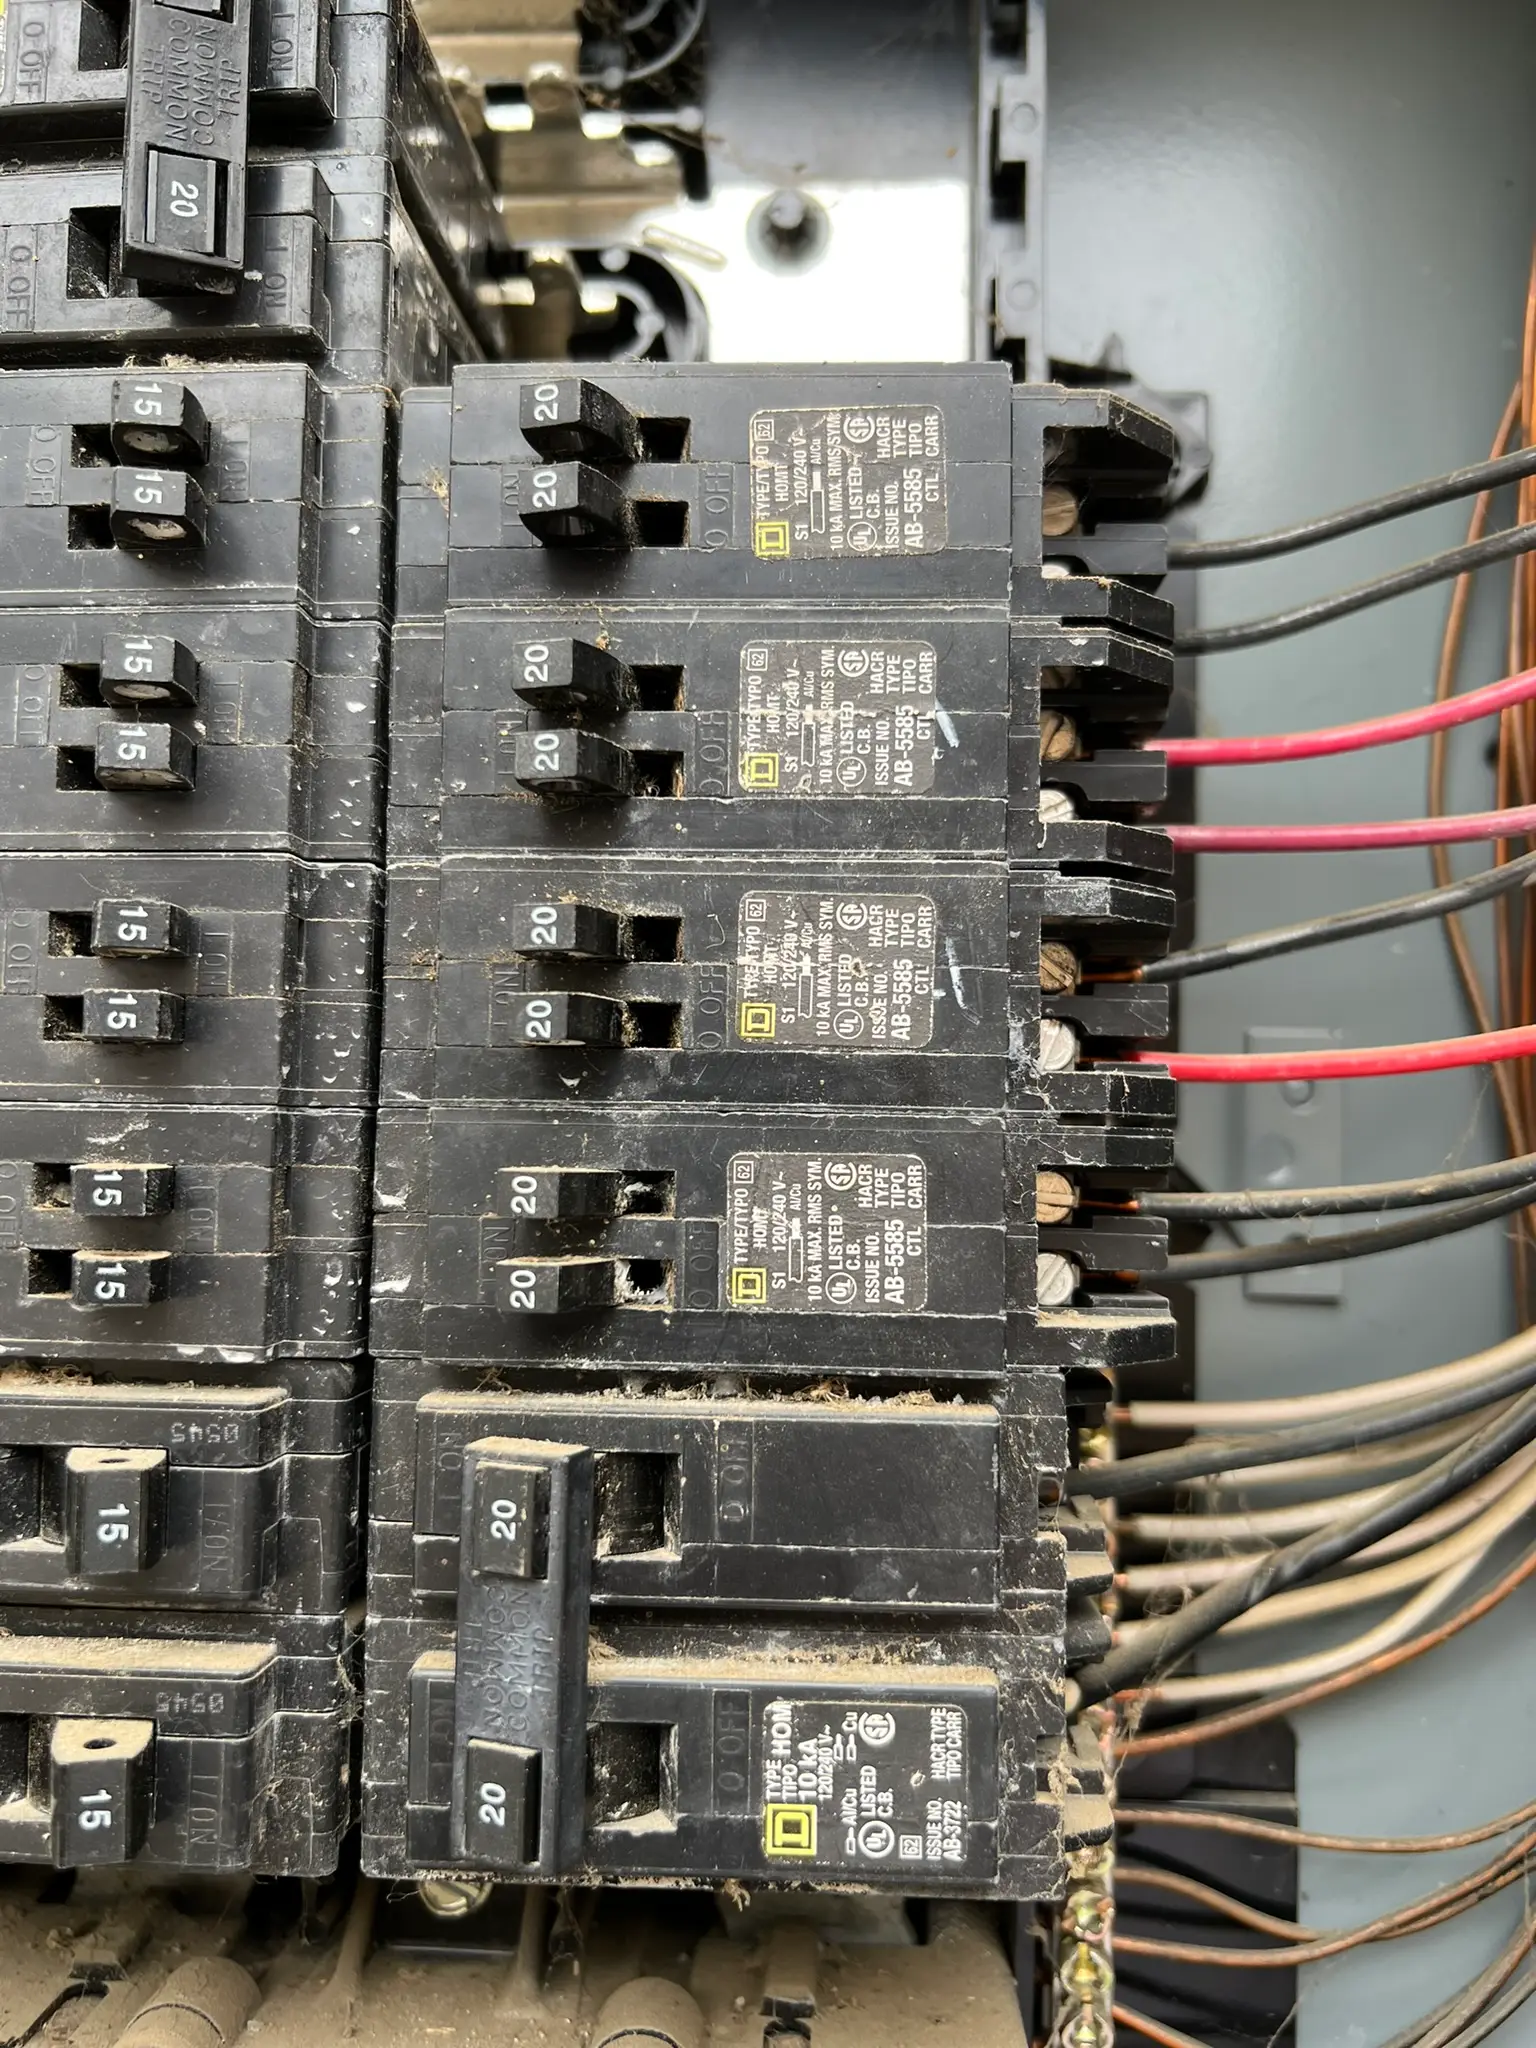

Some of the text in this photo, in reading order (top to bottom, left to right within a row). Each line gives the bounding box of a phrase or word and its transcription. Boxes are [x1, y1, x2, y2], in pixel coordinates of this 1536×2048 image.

[169, 180, 199, 218] 20
[134, 385, 163, 416] 15
[534, 383, 559, 421] 20
[876, 417, 890, 458] HACR
[893, 420, 906, 458] TYPE
[909, 423, 922, 457] TIPO
[925, 416, 938, 456] CARR
[134, 472, 163, 504] 15
[531, 470, 557, 508] 20
[775, 464, 788, 501] HOMT
[794, 449, 809, 540] S1 120/240
[828, 446, 843, 550] 10 kA MAX. RMS
[849, 466, 880, 519] LISTED C.B.
[925, 473, 939, 501] CTL
[885, 481, 899, 548] ISSUE NO.
[903, 468, 923, 548] AB-5585
[124, 639, 153, 674] 15
[524, 645, 549, 683] 20
[752, 653, 764, 666] 62
[870, 651, 884, 693] HACR
[886, 655, 900, 694] TYPE
[919, 652, 932, 694] CARR
[903, 659, 916, 694] TIPO
[786, 682, 799, 737] 120/240
[820, 646, 834, 784] 10 kA RMS SYM.
[117, 727, 147, 761] 15
[534, 734, 560, 772] 20
[857, 724, 870, 754] C.B.
[875, 717, 890, 785] ISSUE NO.
[894, 705, 914, 786] AB-5585
[117, 906, 147, 942] 15
[531, 906, 557, 945] 20
[750, 904, 762, 917] 62
[819, 898, 834, 930] SYM.
[868, 905, 883, 946] HACR
[885, 909, 899, 947] TYPE
[917, 906, 932, 948] CARR
[819, 934, 832, 964] RMS
[901, 913, 915, 947] TIPO
[837, 954, 852, 1006] LISTED
[855, 976, 868, 1007] C.B.
[874, 971, 887, 994] NO.
[915, 966, 929, 994] CTL
[107, 994, 137, 1030] 15
[782, 1008, 795, 1023] S1
[817, 1001, 830, 1018] kA
[891, 959, 912, 1040] AB-5585
[525, 1000, 551, 1038] 20
[817, 1022, 829, 1036] 10
[93, 1170, 123, 1207] 15
[510, 1175, 537, 1215] 20
[790, 1184, 801, 1210] Al/Cu
[858, 1164, 872, 1207] HACR
[875, 1168, 889, 1208] TYPE
[891, 1172, 905, 1208] TIPO
[908, 1165, 922, 1209] CARR
[734, 1166, 750, 1264] TYPE/TYPO 62
[772, 1195, 786, 1252] 120/240
[808, 1158, 822, 1300] 10 kA MAX. RMS SYM.
[829, 1215, 843, 1270] LISTED
[846, 1239, 860, 1270] C.B.
[907, 1226, 921, 1256] CTL
[772, 1272, 786, 1289] S1
[865, 1232, 879, 1303] ISSUE NO.
[885, 1220, 904, 1304] AB-5585
[95, 1263, 127, 1300] 15
[510, 1269, 536, 1309] 20
[169, 1422, 240, 1444] 0545
[98, 1503, 130, 1544] 15
[490, 1499, 517, 1542] 20
[771, 1704, 791, 1757] HOM
[842, 1712, 858, 1733] Cu
[931, 1708, 946, 1779] HACR TYPE
[946, 1712, 961, 1781] TIPO CARR
[766, 1760, 781, 1800] TYPE
[782, 1764, 798, 1801] TIPO
[798, 1738, 817, 1801] 10 kA
[819, 1747, 833, 1801] 120/240
[79, 1788, 112, 1831] 15
[478, 1782, 507, 1827] 20
[860, 1765, 876, 1818] LISTED
[878, 1788, 893, 1818] C.B.
[904, 1840, 919, 1855] 62
[926, 1823, 941, 1860] ISSUE
[943, 1801, 962, 1861] AB-3722
